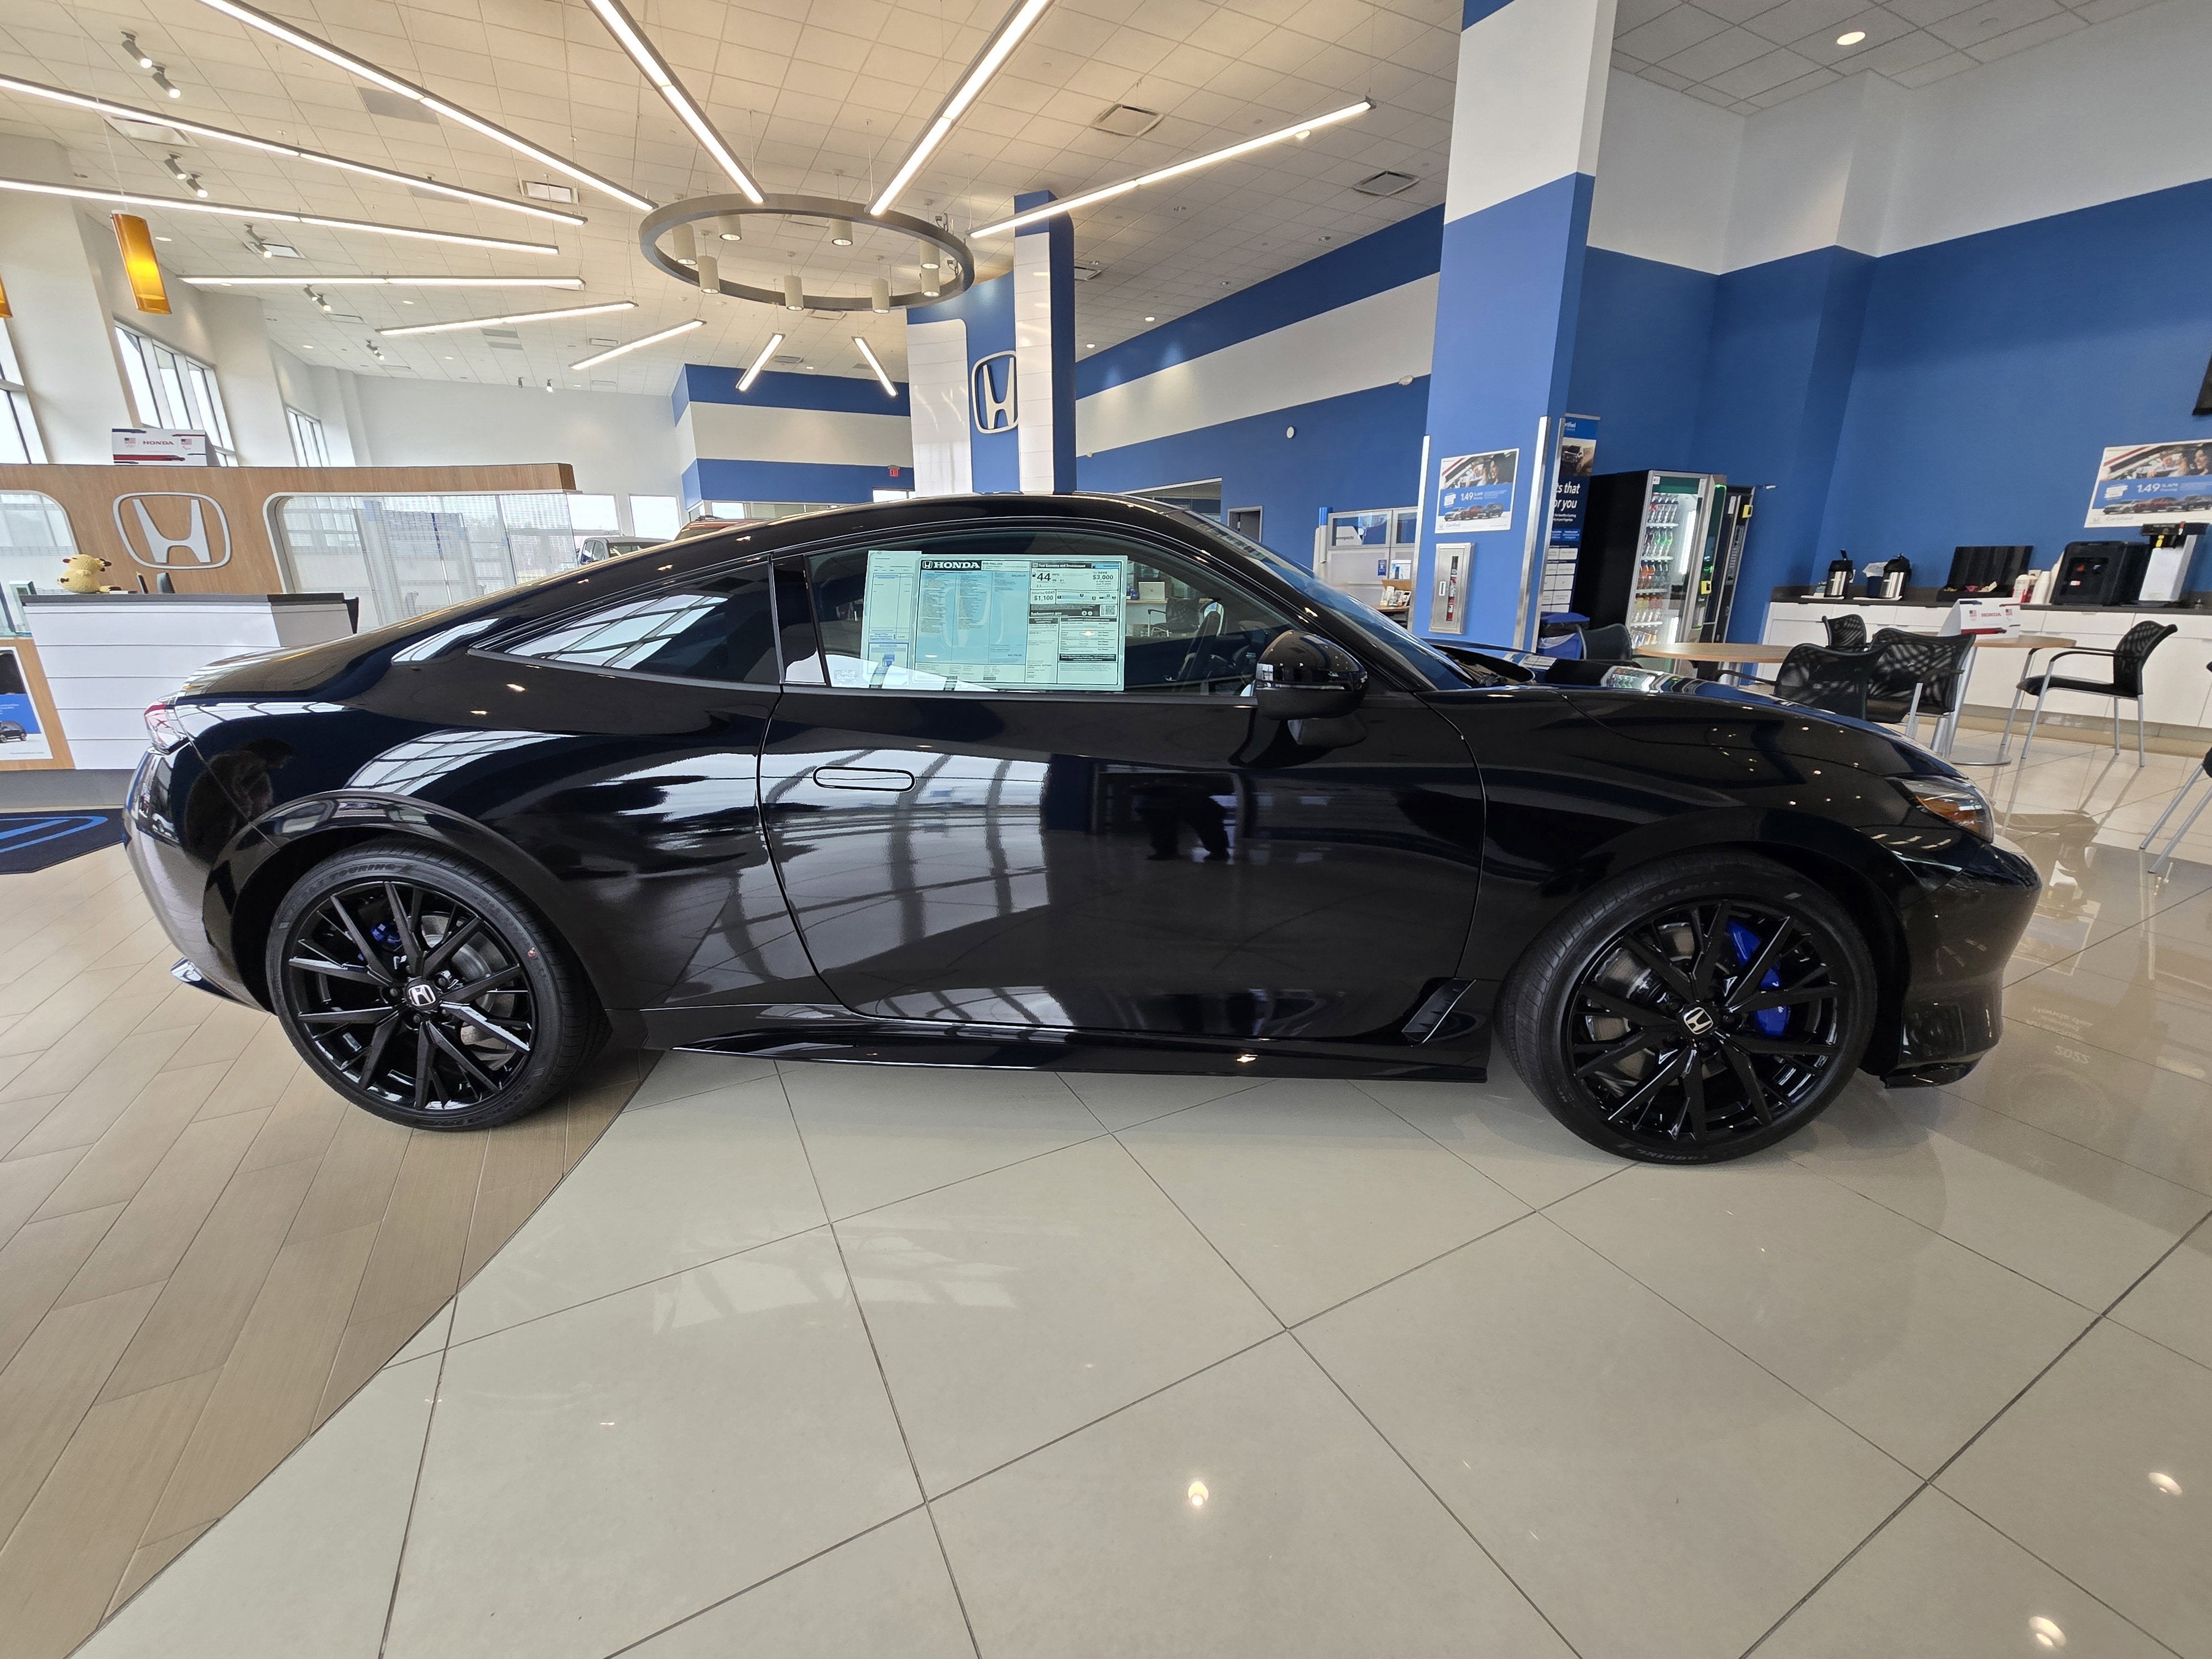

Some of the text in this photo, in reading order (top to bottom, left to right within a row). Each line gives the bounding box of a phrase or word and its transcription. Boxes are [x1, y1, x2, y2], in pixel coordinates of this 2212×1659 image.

[1564, 481, 1580, 494] that
[2137, 483, 2161, 493] 1.49
[1561, 500, 1577, 512] you
[1037, 573, 1051, 581] 44
